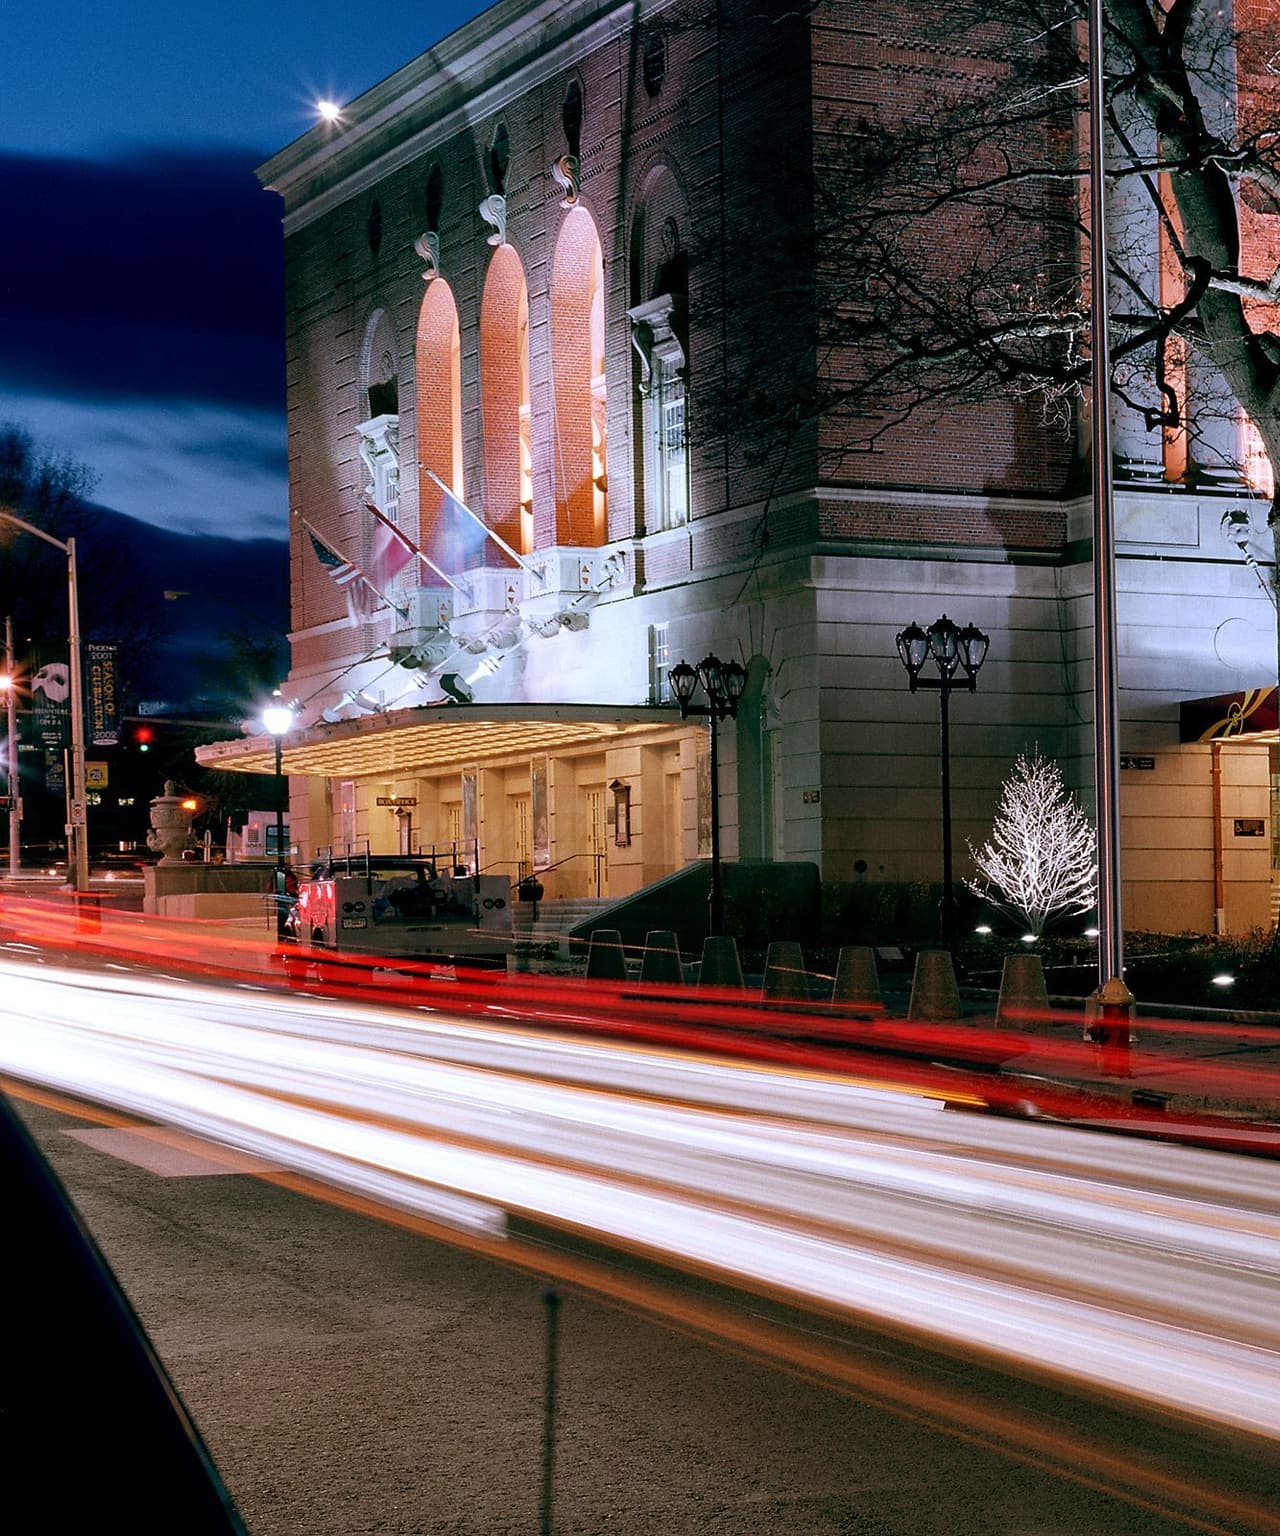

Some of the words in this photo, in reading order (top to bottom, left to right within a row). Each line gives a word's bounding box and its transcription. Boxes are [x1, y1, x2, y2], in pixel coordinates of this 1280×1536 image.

[91, 652, 113, 660] 2001
[103, 661, 114, 700] SEASON
[105, 702, 115, 716] OF
[93, 731, 117, 739] 2002
